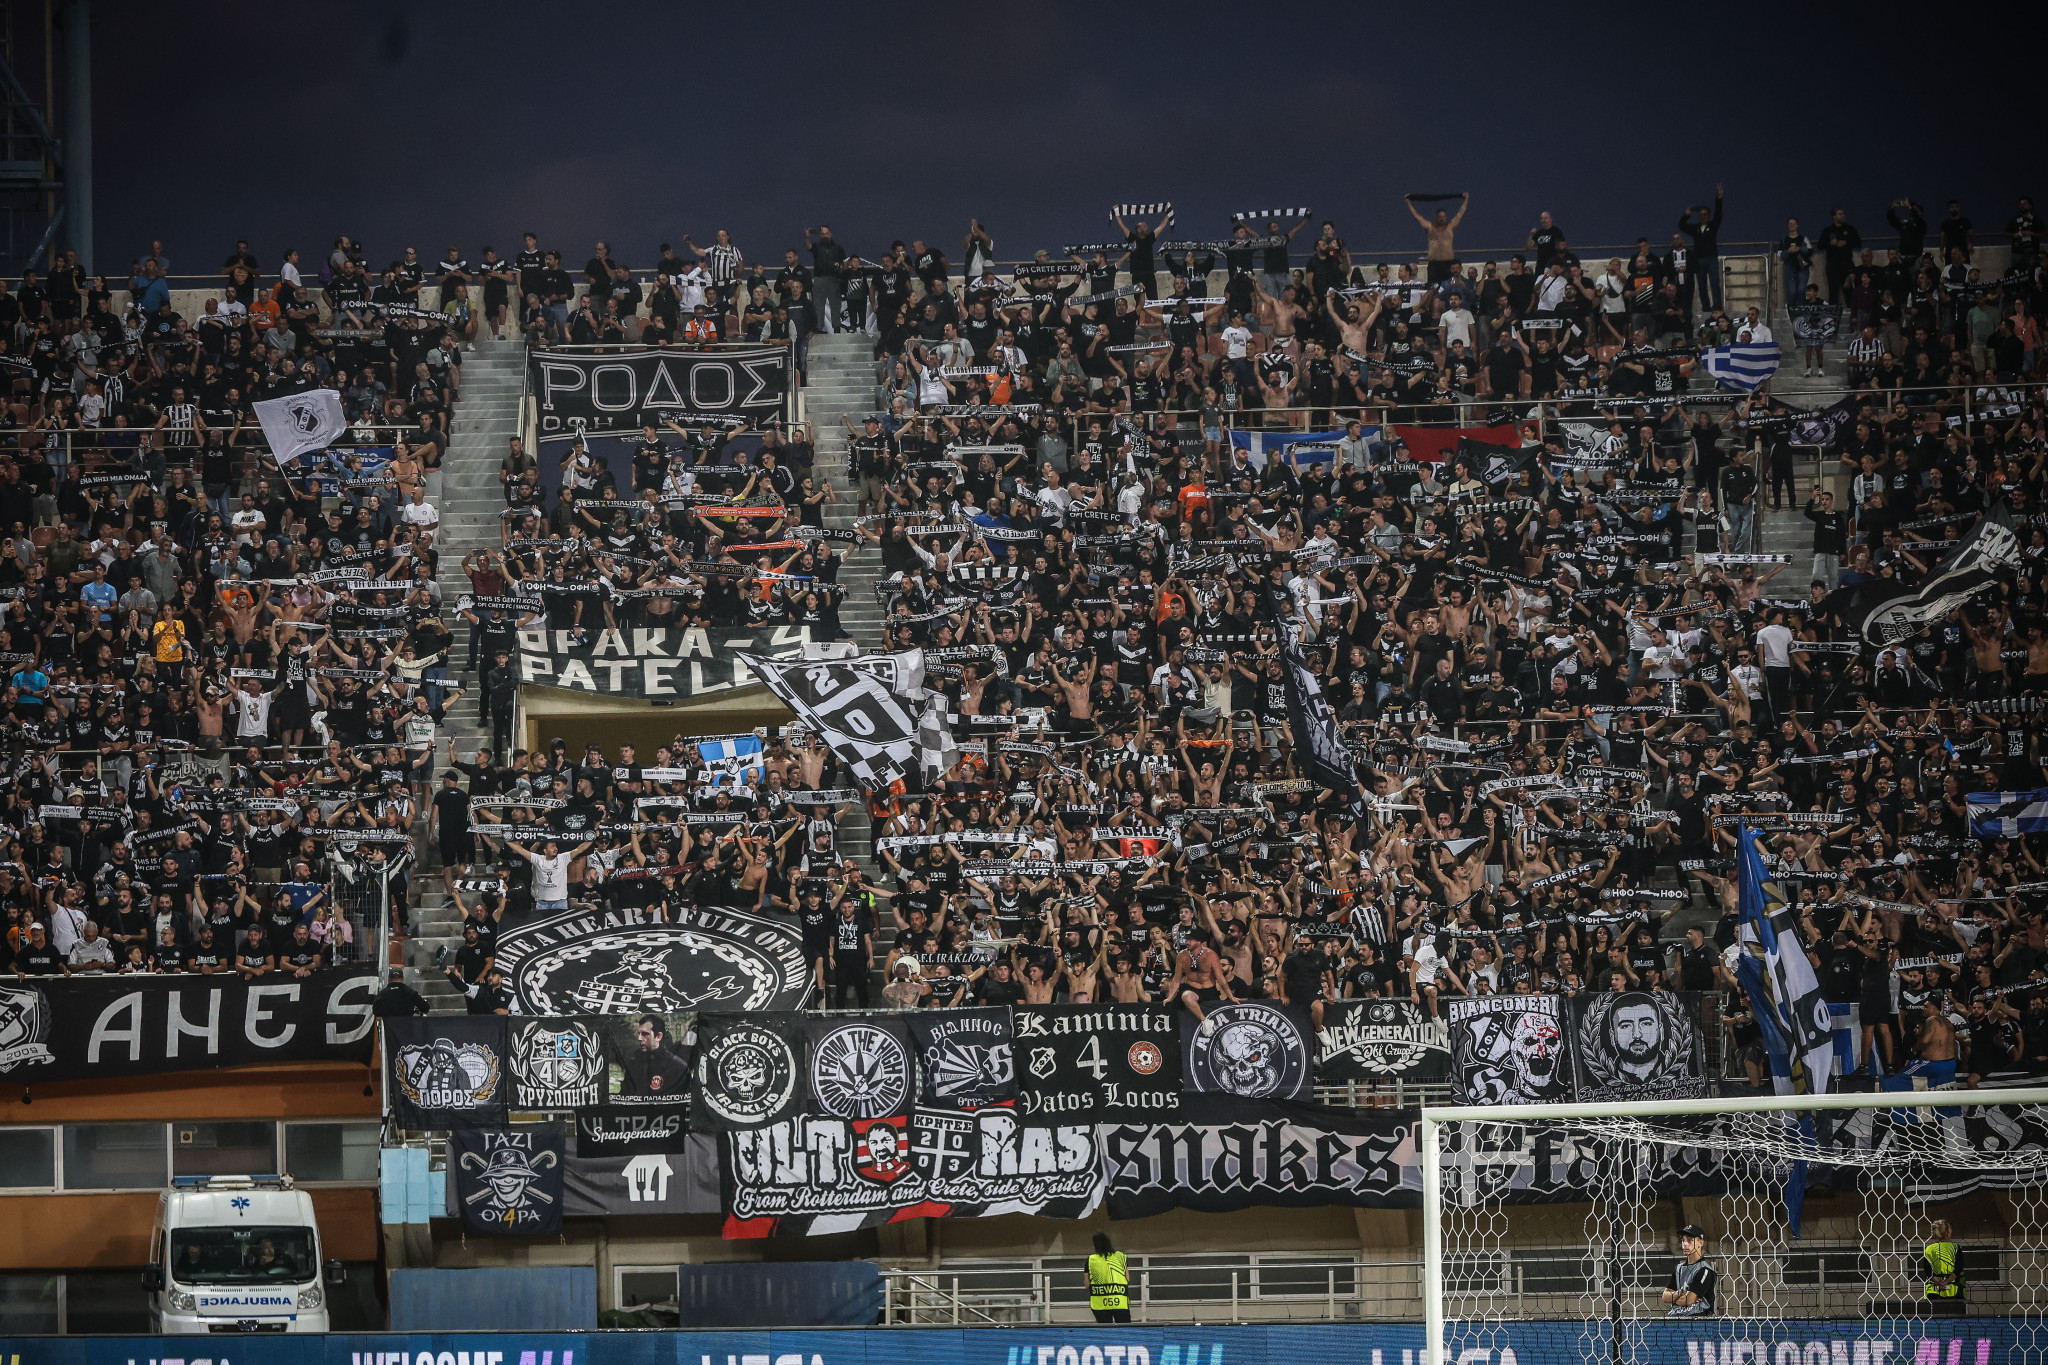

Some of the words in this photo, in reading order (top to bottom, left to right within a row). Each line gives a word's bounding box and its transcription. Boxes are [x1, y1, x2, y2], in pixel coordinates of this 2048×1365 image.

[1016, 265, 1029, 275] OFI
[1030, 265, 1056, 273] CRETE
[540, 356, 784, 412] ΡΟΔΟΣ
[1485, 463, 1512, 480] Ο.Φ.Η.
[239, 514, 256, 524] NIKE
[1084, 511, 1109, 521] CRETE
[1110, 513, 1121, 522] FC
[924, 525, 945, 533] CRETE
[1596, 535, 1617, 545] ΟΦΗ
[1639, 533, 1660, 543] ΟΦΗ
[330, 555, 344, 564] OFI
[345, 551, 370, 561] CRETE
[372, 548, 386, 557] FC
[1464, 562, 1475, 570] OFI
[1475, 565, 1495, 576] CRETE
[1496, 570, 1505, 578] FC
[1509, 573, 1527, 583] SINCE
[1528, 577, 1541, 586] 1925
[526, 583, 546, 591] ΟΦΗ
[570, 583, 590, 591] ΟΦΗ
[494, 595, 500, 603] IS
[336, 605, 356, 614] OFI
[357, 605, 394, 615] CRETE
[397, 605, 410, 614] FC
[1268, 696, 1286, 705] RAS
[1632, 704, 1666, 712] WINNERS
[1436, 742, 1451, 750] CRETE
[1582, 768, 1602, 777] ΟΦΗ
[1623, 769, 1643, 780] ΟΦΗ
[1071, 803, 1098, 812] Ο.Φ.Η.
[1791, 814, 1816, 822] CRETE
[1817, 814, 1836, 822] 1925
[514, 831, 537, 840] ΟΦΗ
[561, 832, 583, 841] ΟΦΗ
[1212, 839, 1227, 849] OFI
[1226, 831, 1252, 844] CRETE
[962, 868, 1005, 877] KRITES
[1017, 867, 1050, 876] GATE
[1532, 878, 1549, 888] OFI
[1549, 869, 1579, 884] CRETE
[1578, 864, 1591, 874] FC
[1578, 916, 1600, 925] ΟΦΗ
[494, 939, 538, 978] HAVE
[533, 931, 550, 947] A
[753, 930, 791, 960] OF
[780, 947, 807, 994] PRIDE
[936, 952, 981, 963] IRAKLIO
[1448, 994, 1560, 1024] BIANCONERI
[1014, 1006, 1174, 1039] Kaminia
[1234, 1007, 1300, 1052] TRIADA
[1361, 1017, 1449, 1049] GENERATION
[1477, 1020, 1507, 1059] Ο.Φ.Η.
[6, 1046, 39, 1059] 2009
[708, 1032, 747, 1060] BLACK
[750, 1032, 782, 1058] BOYS
[818, 1033, 850, 1077] FROM
[847, 1029, 879, 1053] THE
[873, 1036, 904, 1077] HIGH
[1075, 1034, 1109, 1081] 4
[410, 1055, 431, 1087] Ο.Φ.Η.
[539, 1060, 554, 1083] 4
[419, 1088, 477, 1110] ΠΟΡΟΣ
[516, 1083, 599, 1107] ΧΡΥΣΟΠΗΓΗ
[608, 1093, 643, 1102] ΘΕΟΔΩΡΟΣ
[714, 1092, 779, 1114] IRAKLIO
[817, 1074, 904, 1119] MOUNTAINS
[1019, 1089, 1095, 1116] Vatos
[1101, 1081, 1180, 1110] Locos
[913, 1114, 974, 1132] ΚΡΗΤΕΣ
[483, 1132, 533, 1153] ΓΑΖΙ
[591, 1125, 671, 1144] Spangenaren
[920, 1132, 932, 1146] 2
[952, 1134, 962, 1149] 0
[917, 1155, 928, 1168] 0
[948, 1159, 960, 1172] 3
[1107, 1117, 1412, 1197] snakes
[740, 1188, 787, 1212] From
[793, 1186, 889, 1210] Rotterdam
[891, 1180, 925, 1200] and
[927, 1177, 980, 1199] Crete,
[984, 1177, 1020, 1196] side
[1023, 1176, 1046, 1199] by
[1049, 1174, 1092, 1195] side!
[1091, 1285, 1126, 1295] STEWARD
